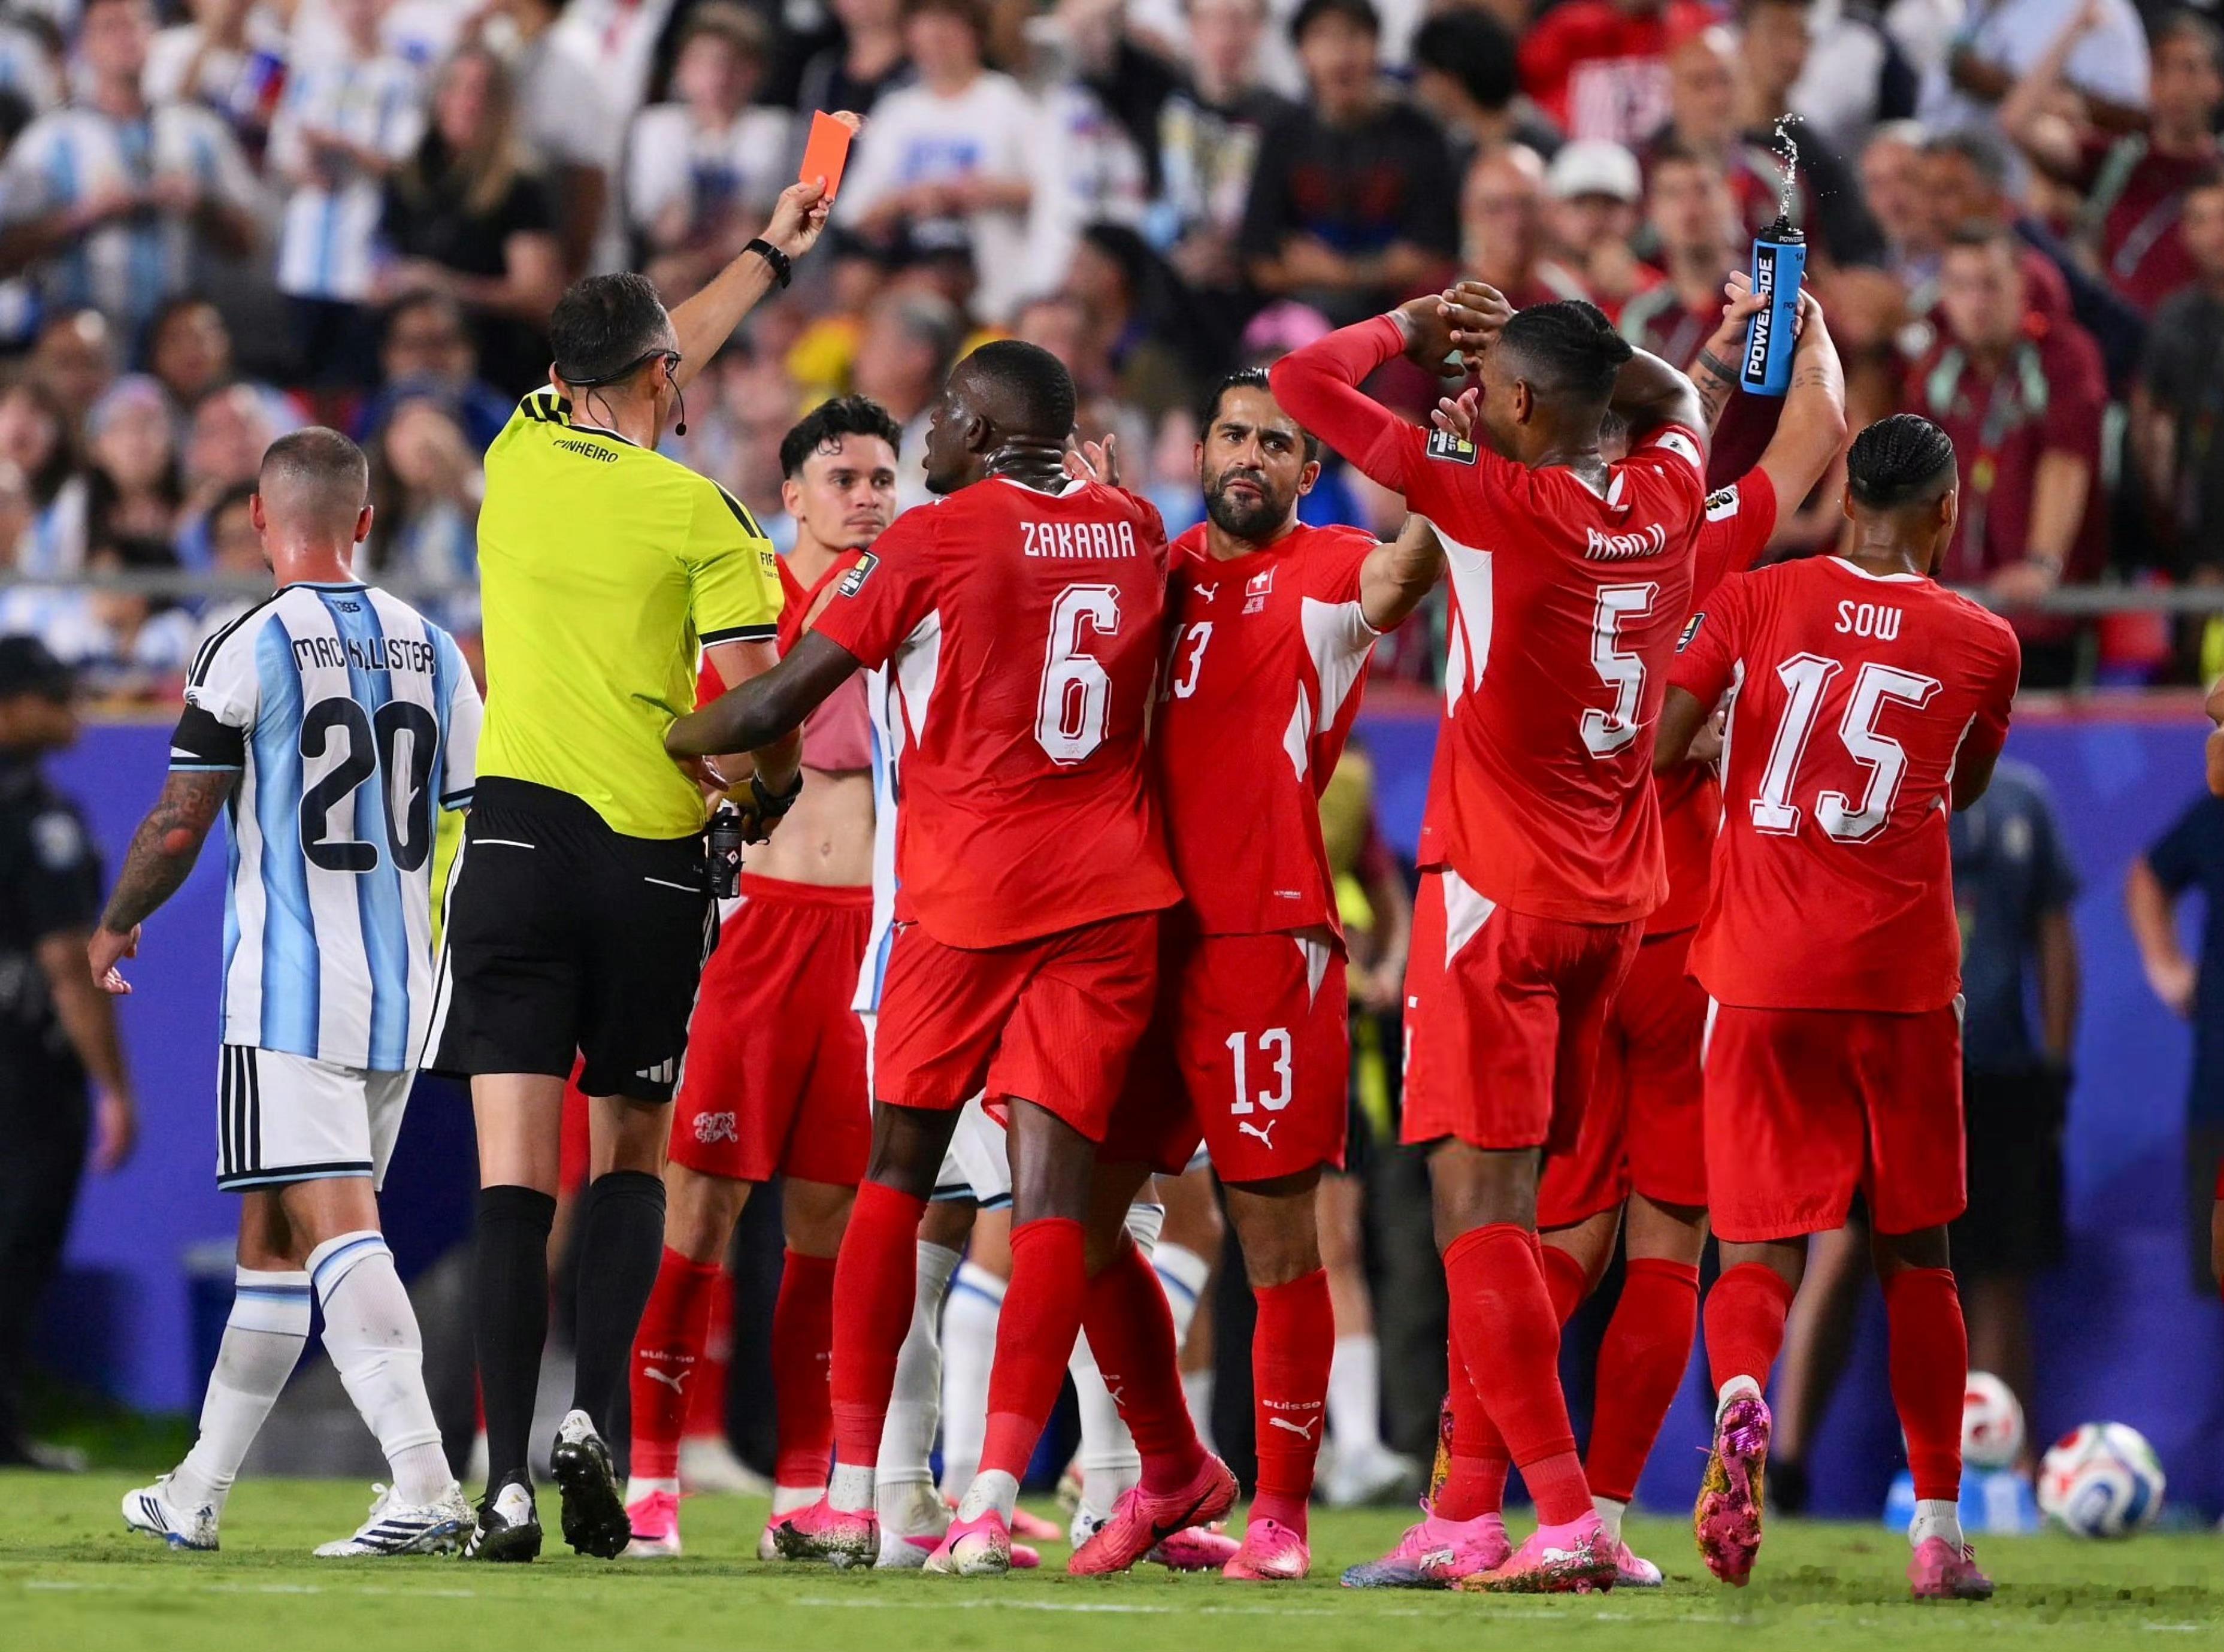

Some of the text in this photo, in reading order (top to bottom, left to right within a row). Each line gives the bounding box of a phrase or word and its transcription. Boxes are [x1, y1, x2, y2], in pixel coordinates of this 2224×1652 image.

[1747, 256, 1773, 376] POWEADE
[553, 439, 619, 463] PINHEIRO
[1019, 521, 1136, 559] ZAKARIA
[1584, 523, 1666, 560] AKANJI
[291, 636, 346, 671] MAC
[1834, 600, 1902, 641] SOW
[1034, 583, 1121, 766] 6
[1580, 581, 1660, 760] 5
[298, 697, 439, 873] 20
[1749, 651, 1943, 845] 15
[1225, 1027, 1292, 1115] 13
